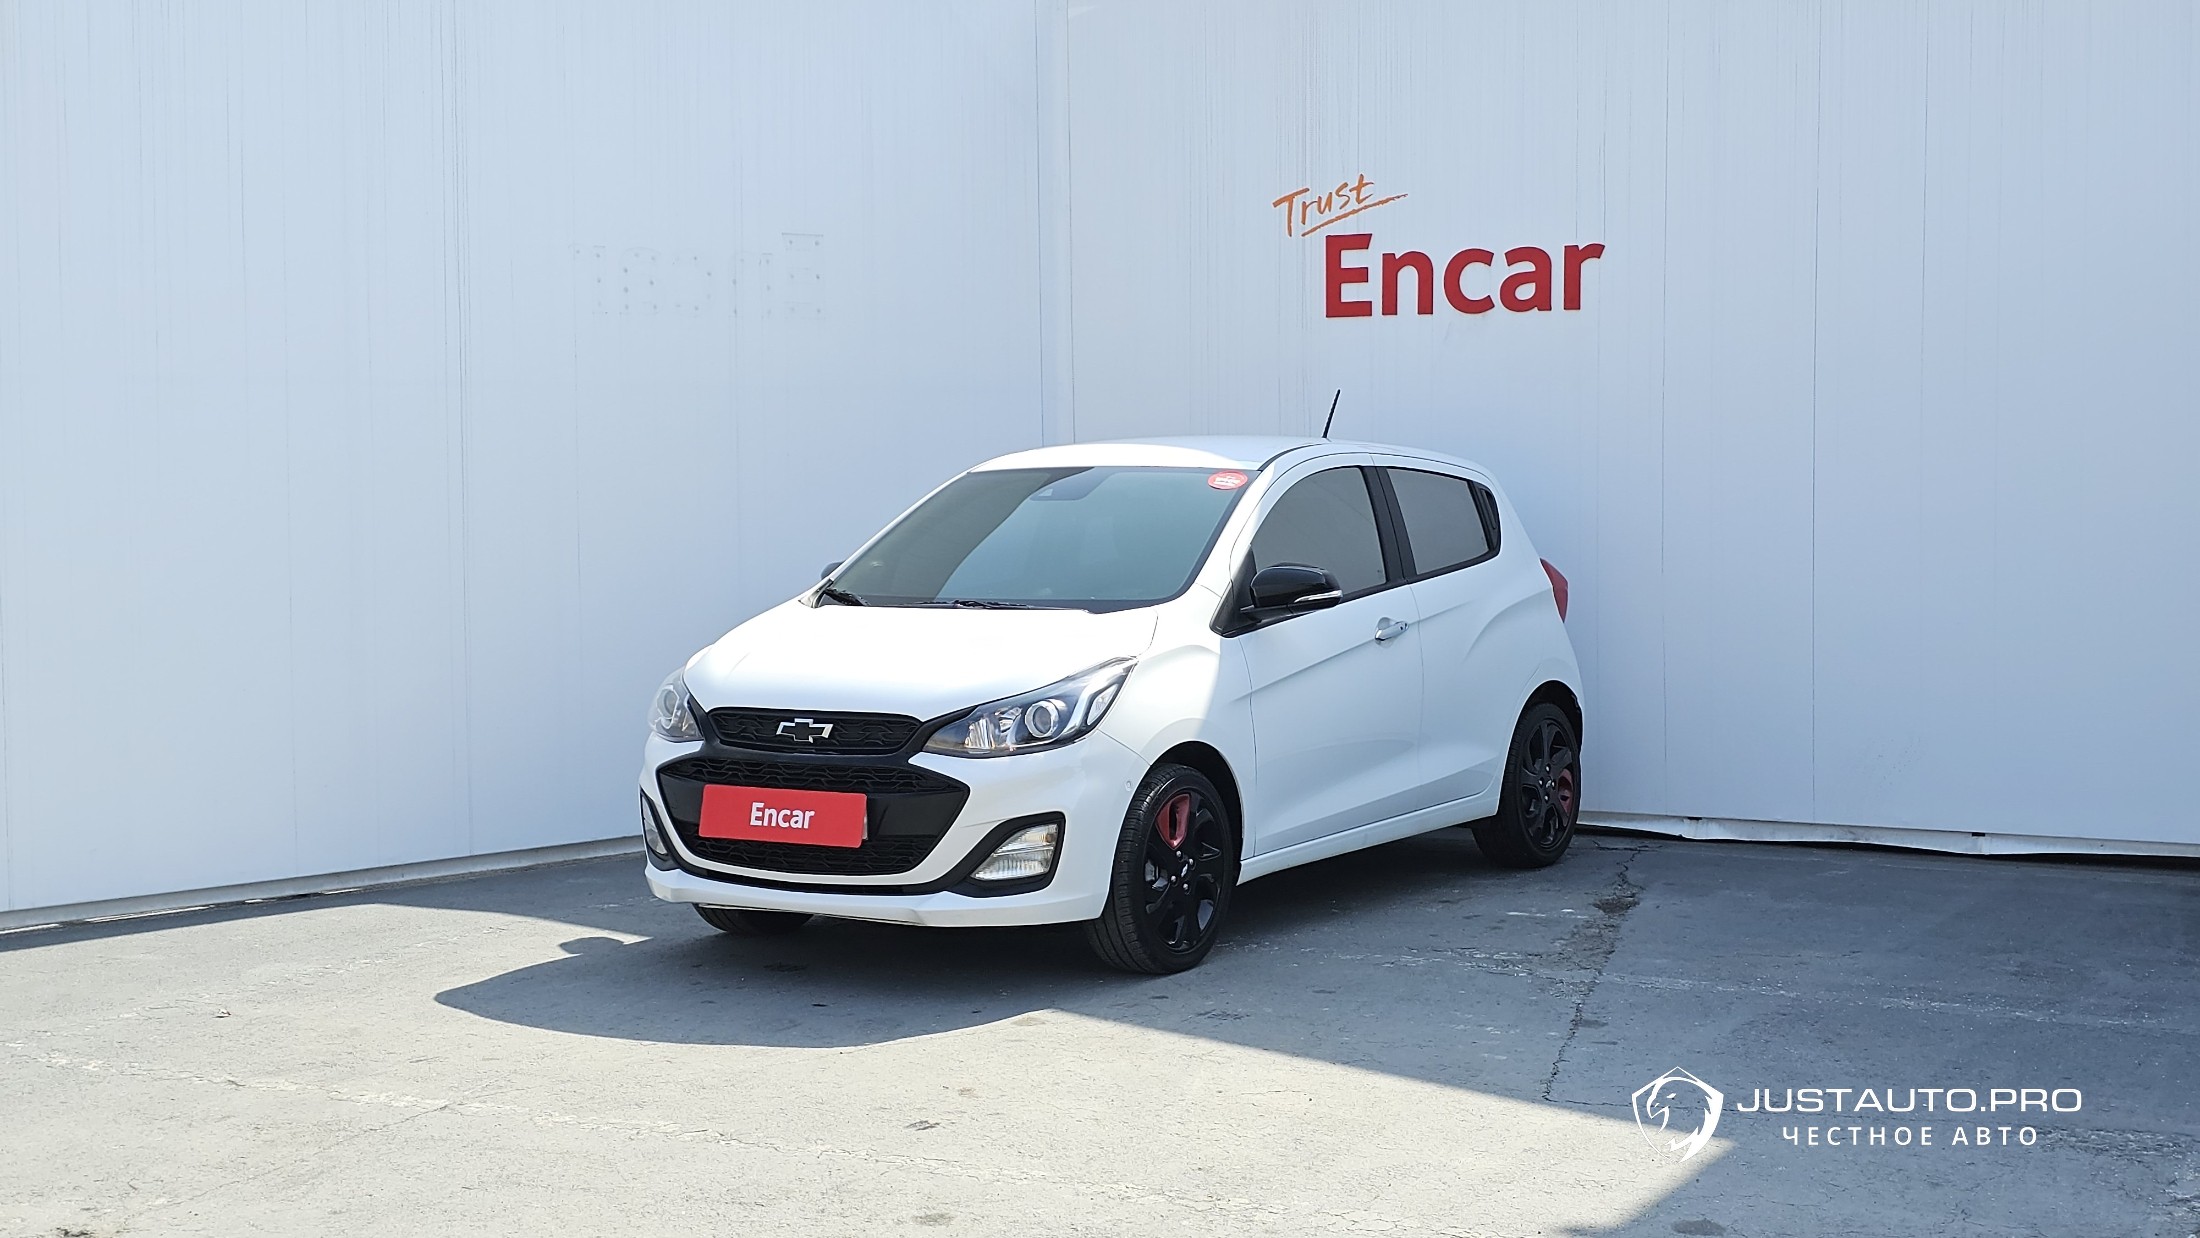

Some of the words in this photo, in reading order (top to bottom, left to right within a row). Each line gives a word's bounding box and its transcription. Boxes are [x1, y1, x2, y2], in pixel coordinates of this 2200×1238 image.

[1272, 173, 1375, 238] Trust
[1325, 233, 1606, 318] Encar
[750, 802, 816, 829] Encar
